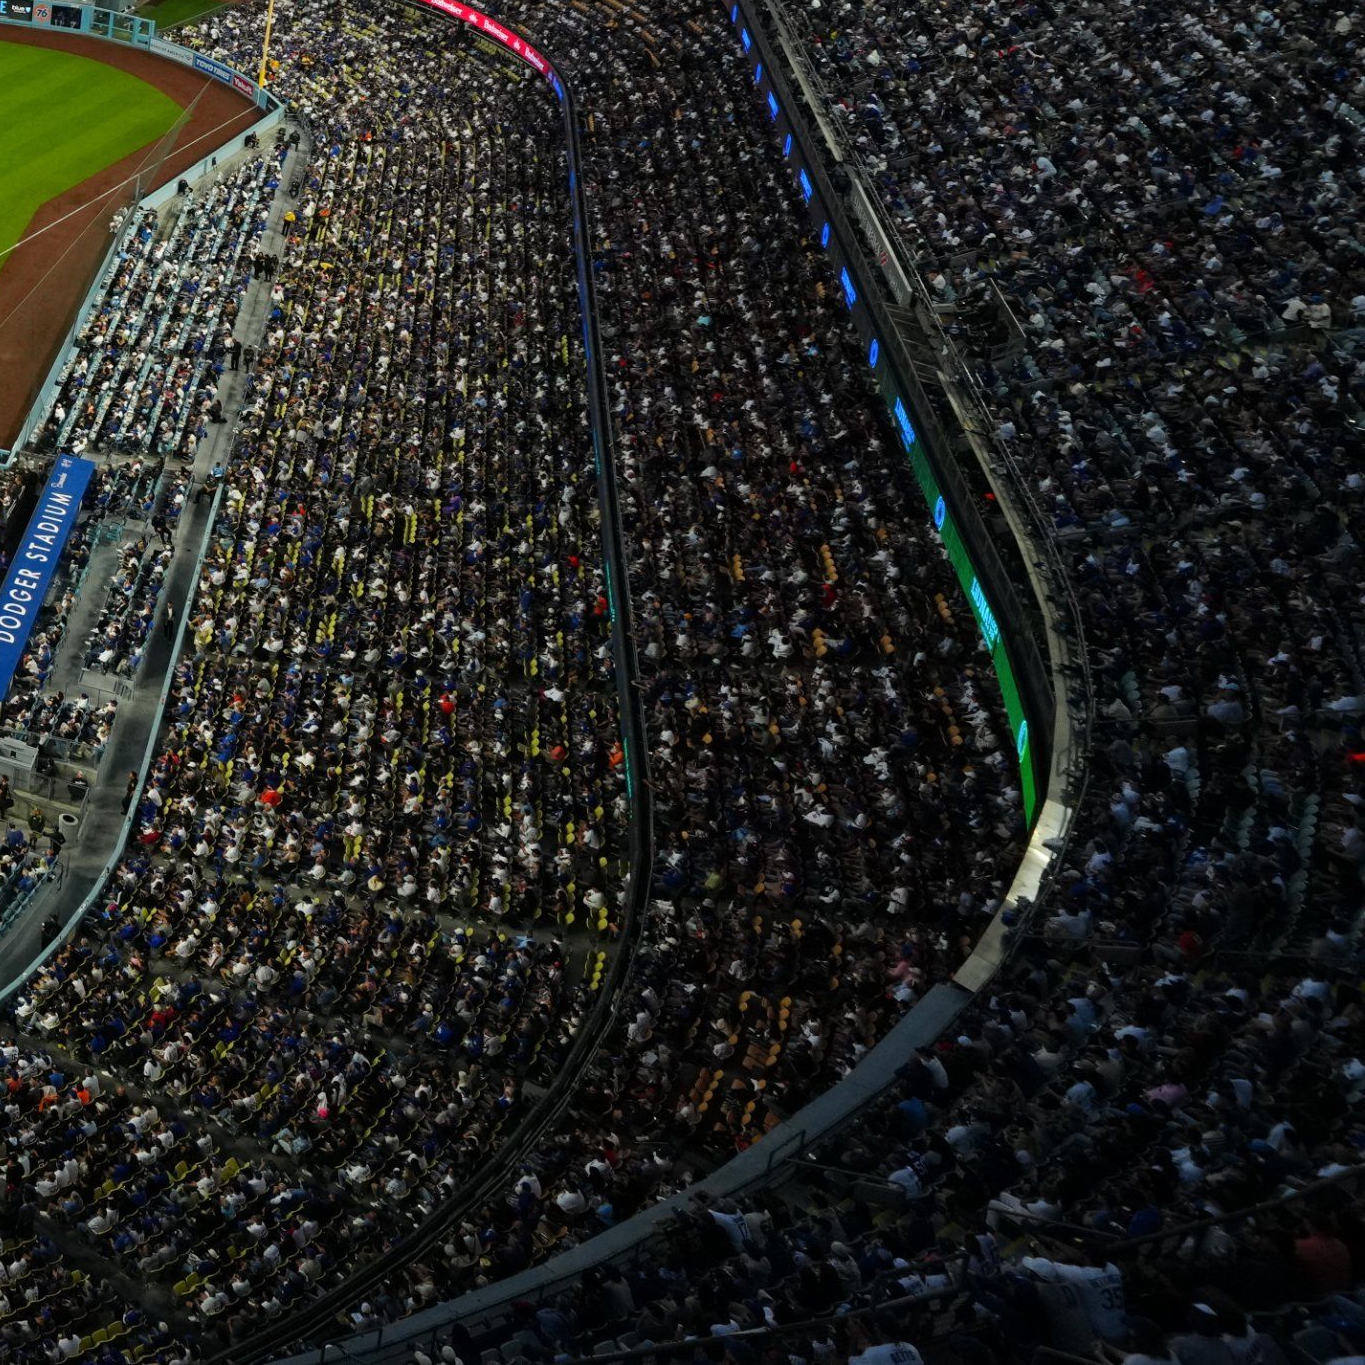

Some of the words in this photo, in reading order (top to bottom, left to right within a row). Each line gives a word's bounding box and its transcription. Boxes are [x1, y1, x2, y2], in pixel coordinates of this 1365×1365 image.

[36, 8, 49, 18] 76
[483, 19, 509, 42] Budweiser
[25, 492, 73, 563] STADIUM
